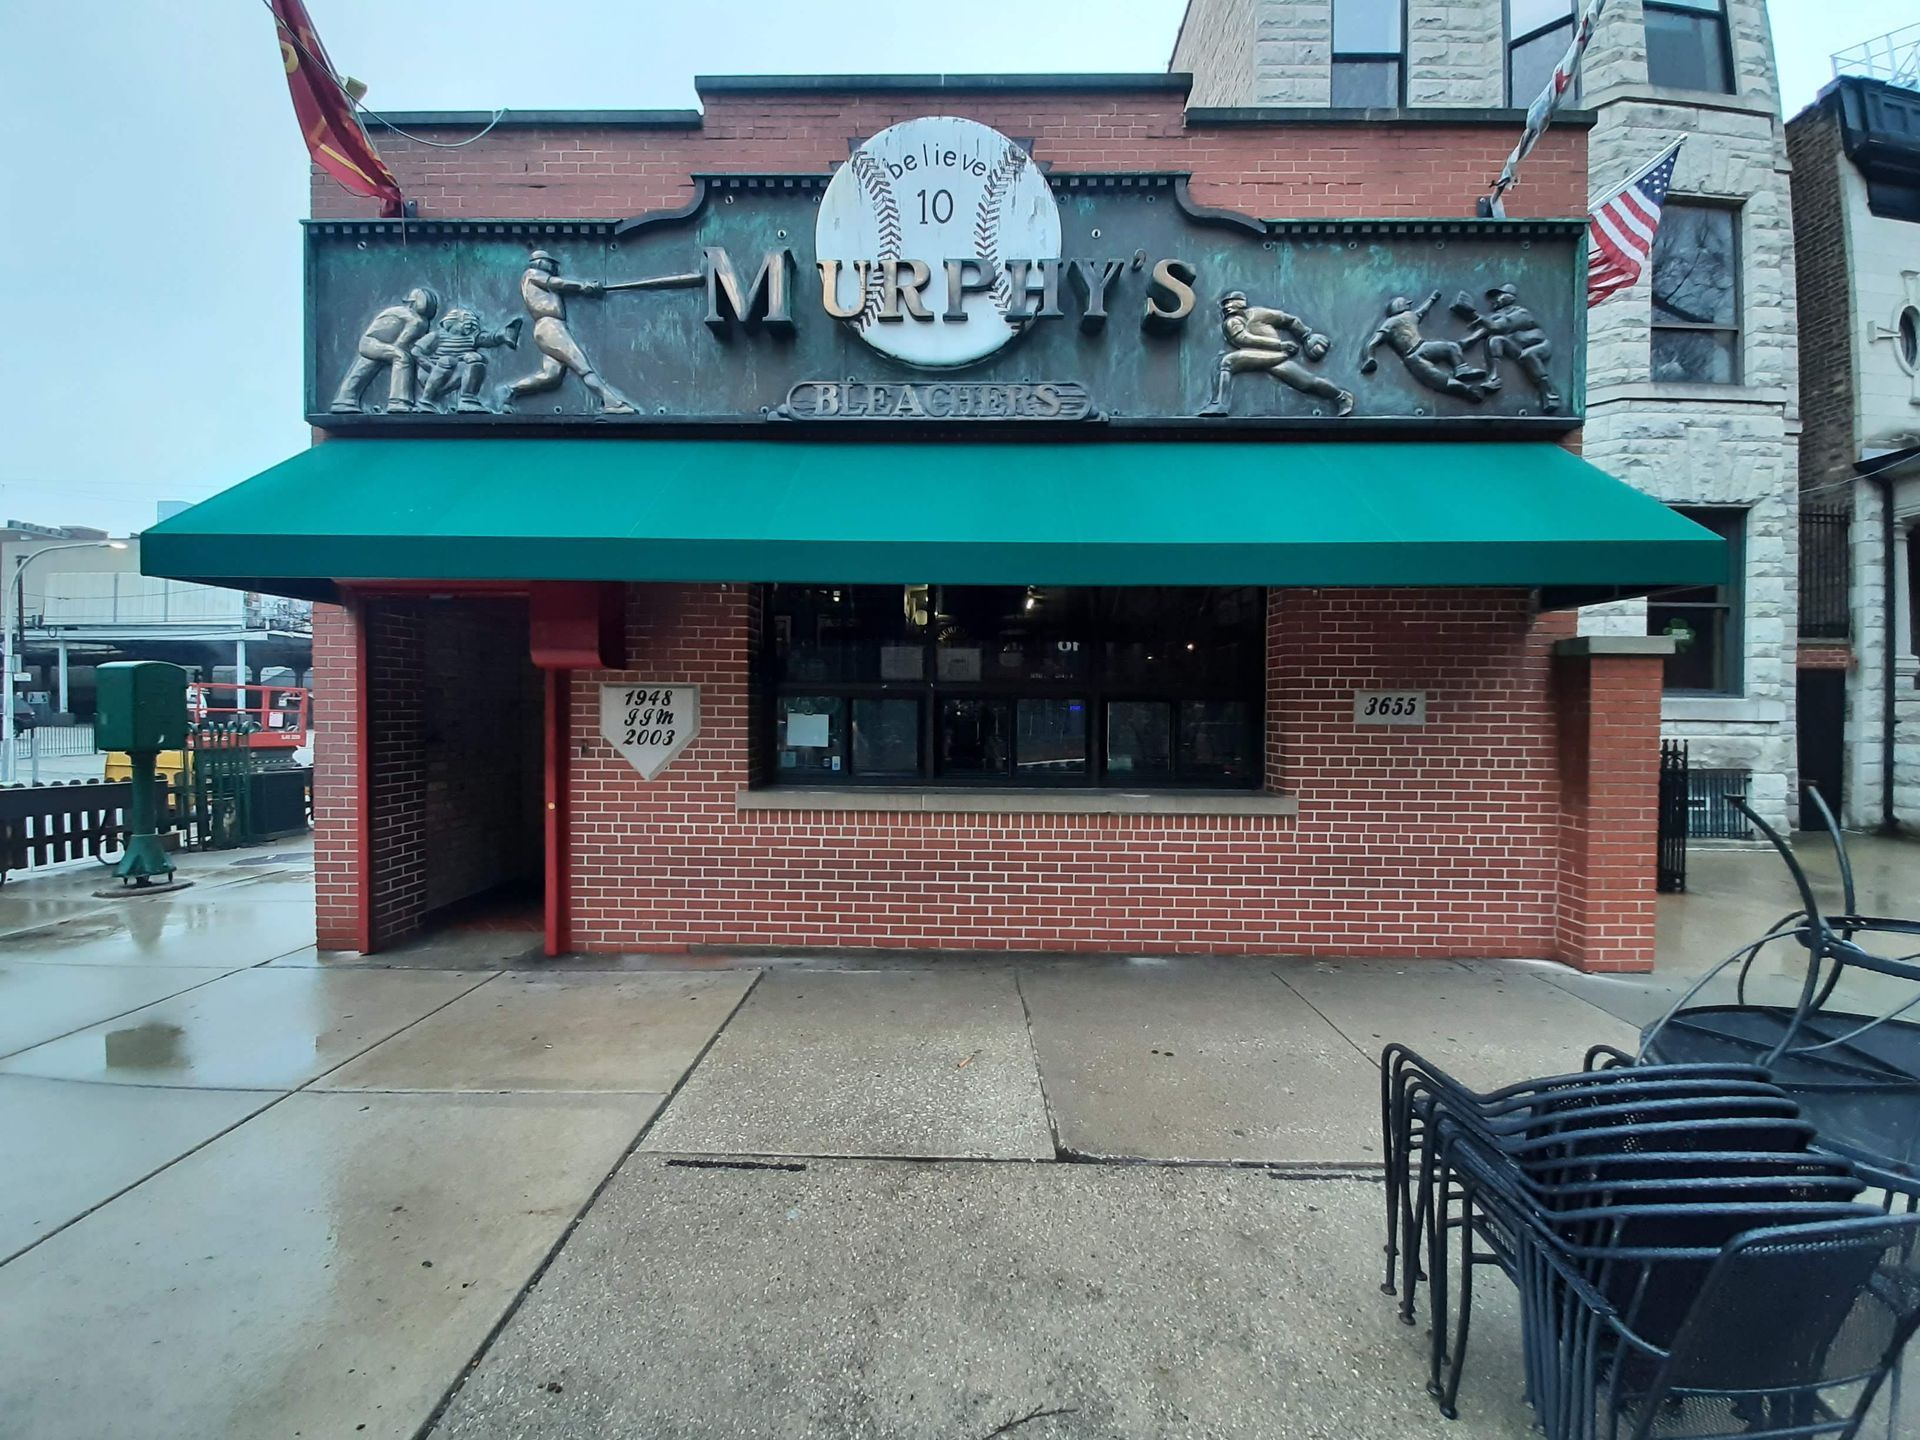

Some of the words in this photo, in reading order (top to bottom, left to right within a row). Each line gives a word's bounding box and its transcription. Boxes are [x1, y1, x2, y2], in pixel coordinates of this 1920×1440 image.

[886, 143, 987, 180] believe
[917, 189, 954, 225] 10
[703, 246, 1197, 325] MURPHY'S
[812, 384, 1063, 419] BLEACHERS
[624, 689, 673, 706] 1948
[1363, 696, 1417, 716] 3655
[622, 729, 675, 746] 2003
